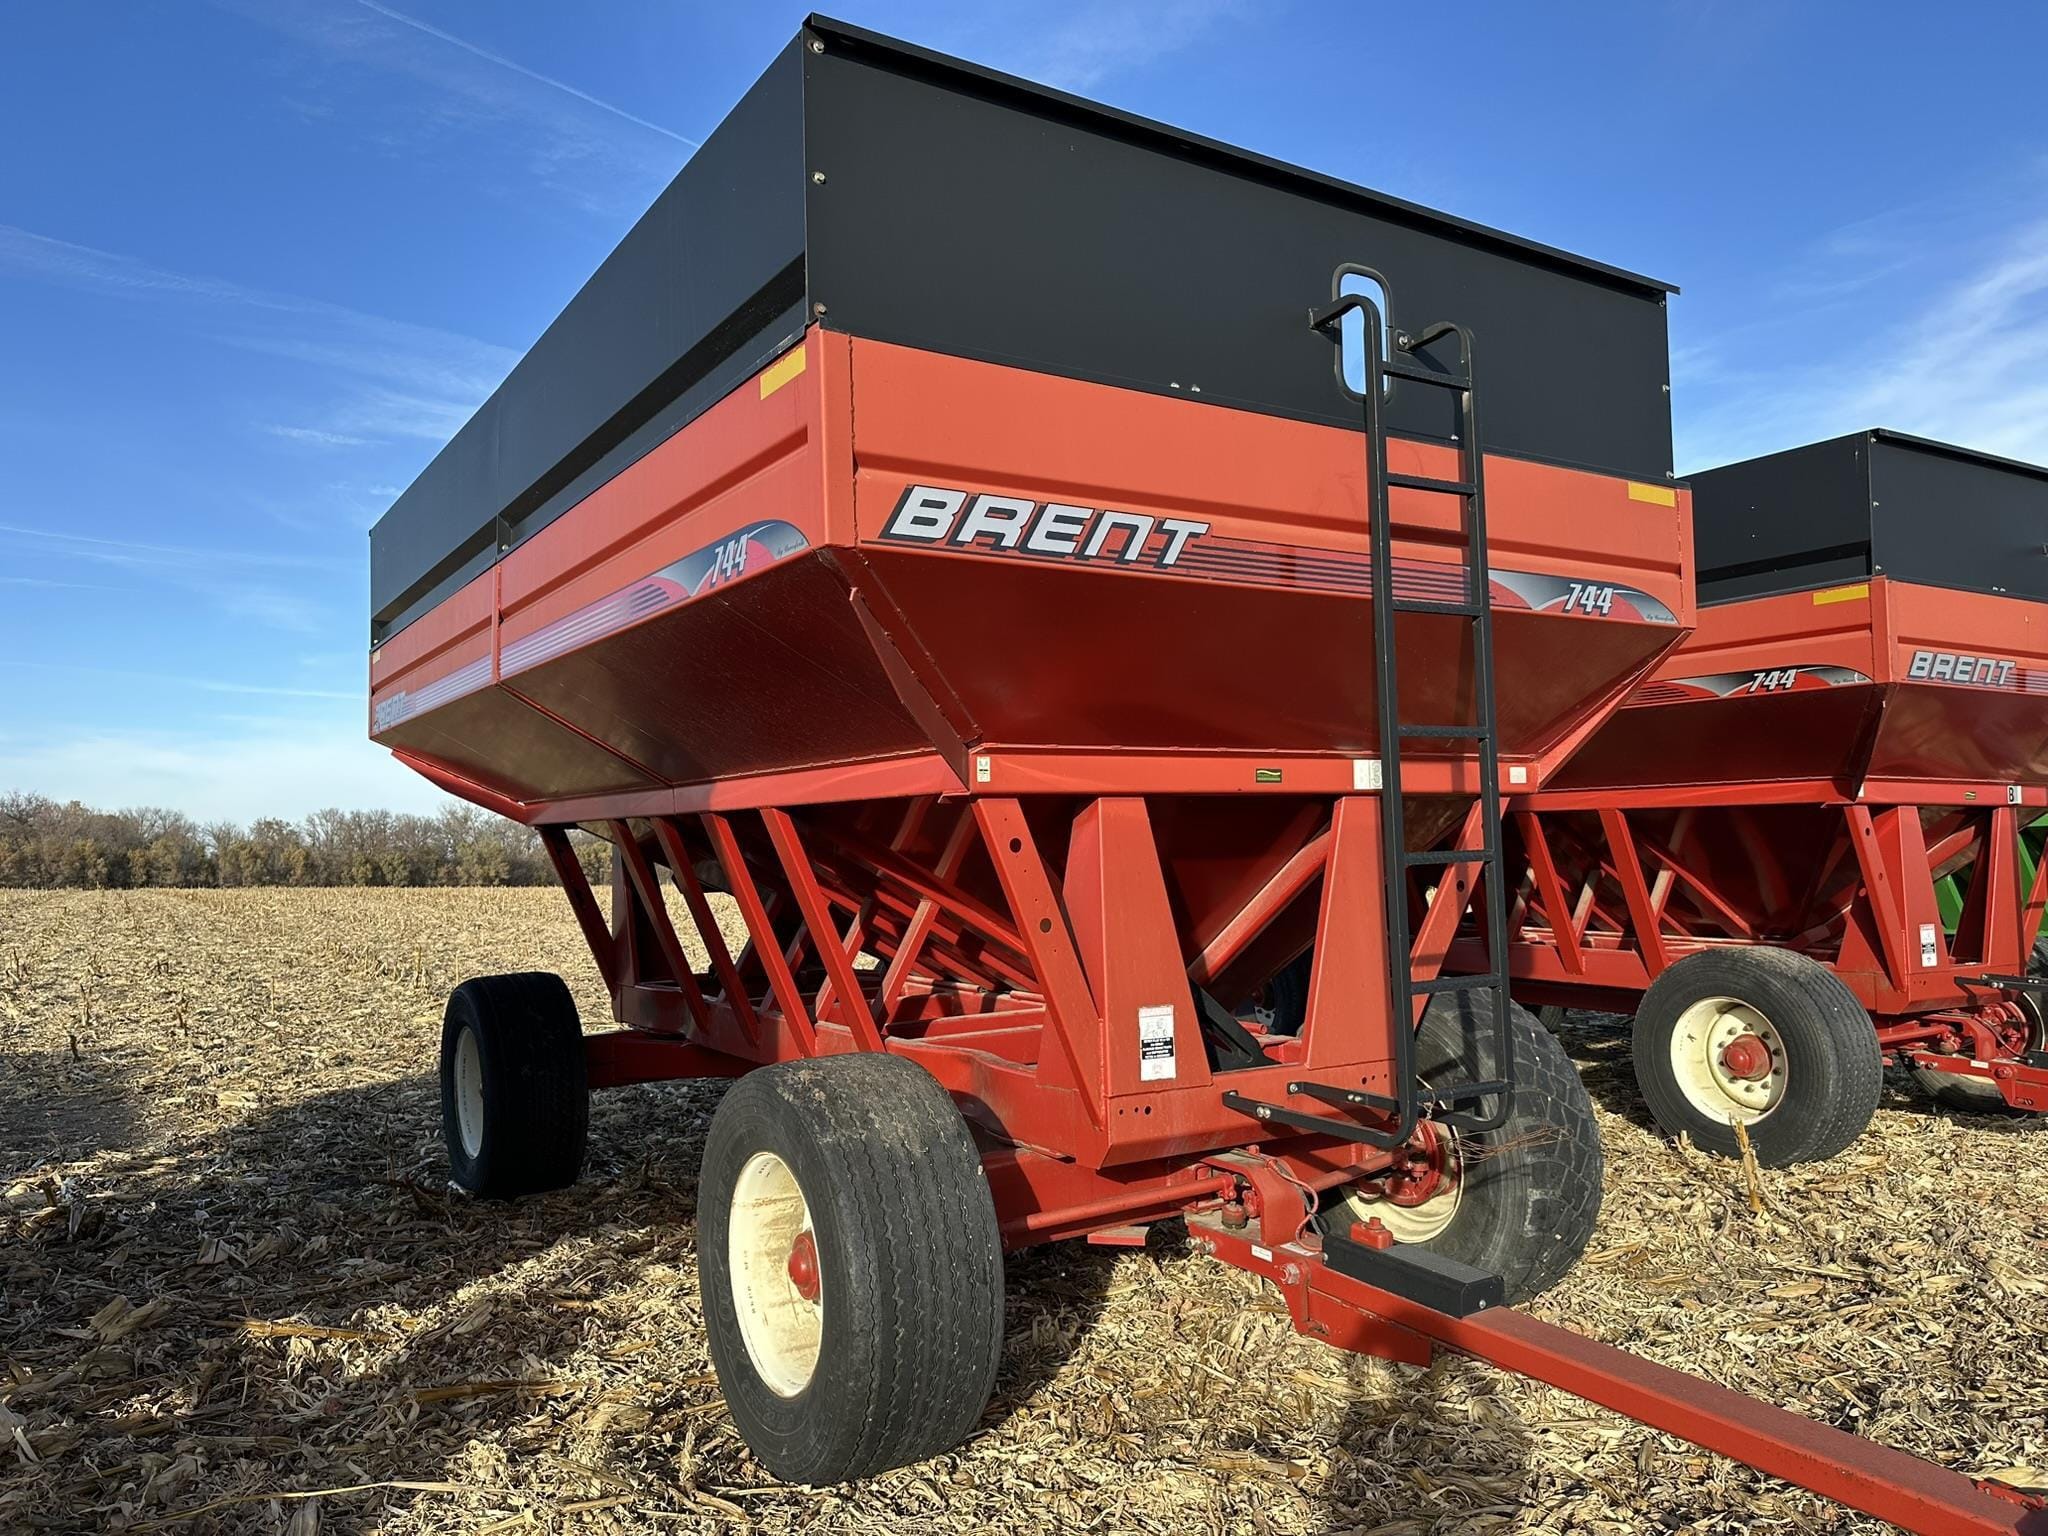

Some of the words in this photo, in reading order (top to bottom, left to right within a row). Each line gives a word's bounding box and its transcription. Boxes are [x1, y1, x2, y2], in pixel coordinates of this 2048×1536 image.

[880, 484, 1210, 567] BRENT
[710, 533, 748, 587] 744
[1563, 583, 1614, 615] 744
[1748, 669, 1796, 692] 744
[1908, 650, 2016, 686] BRENT
